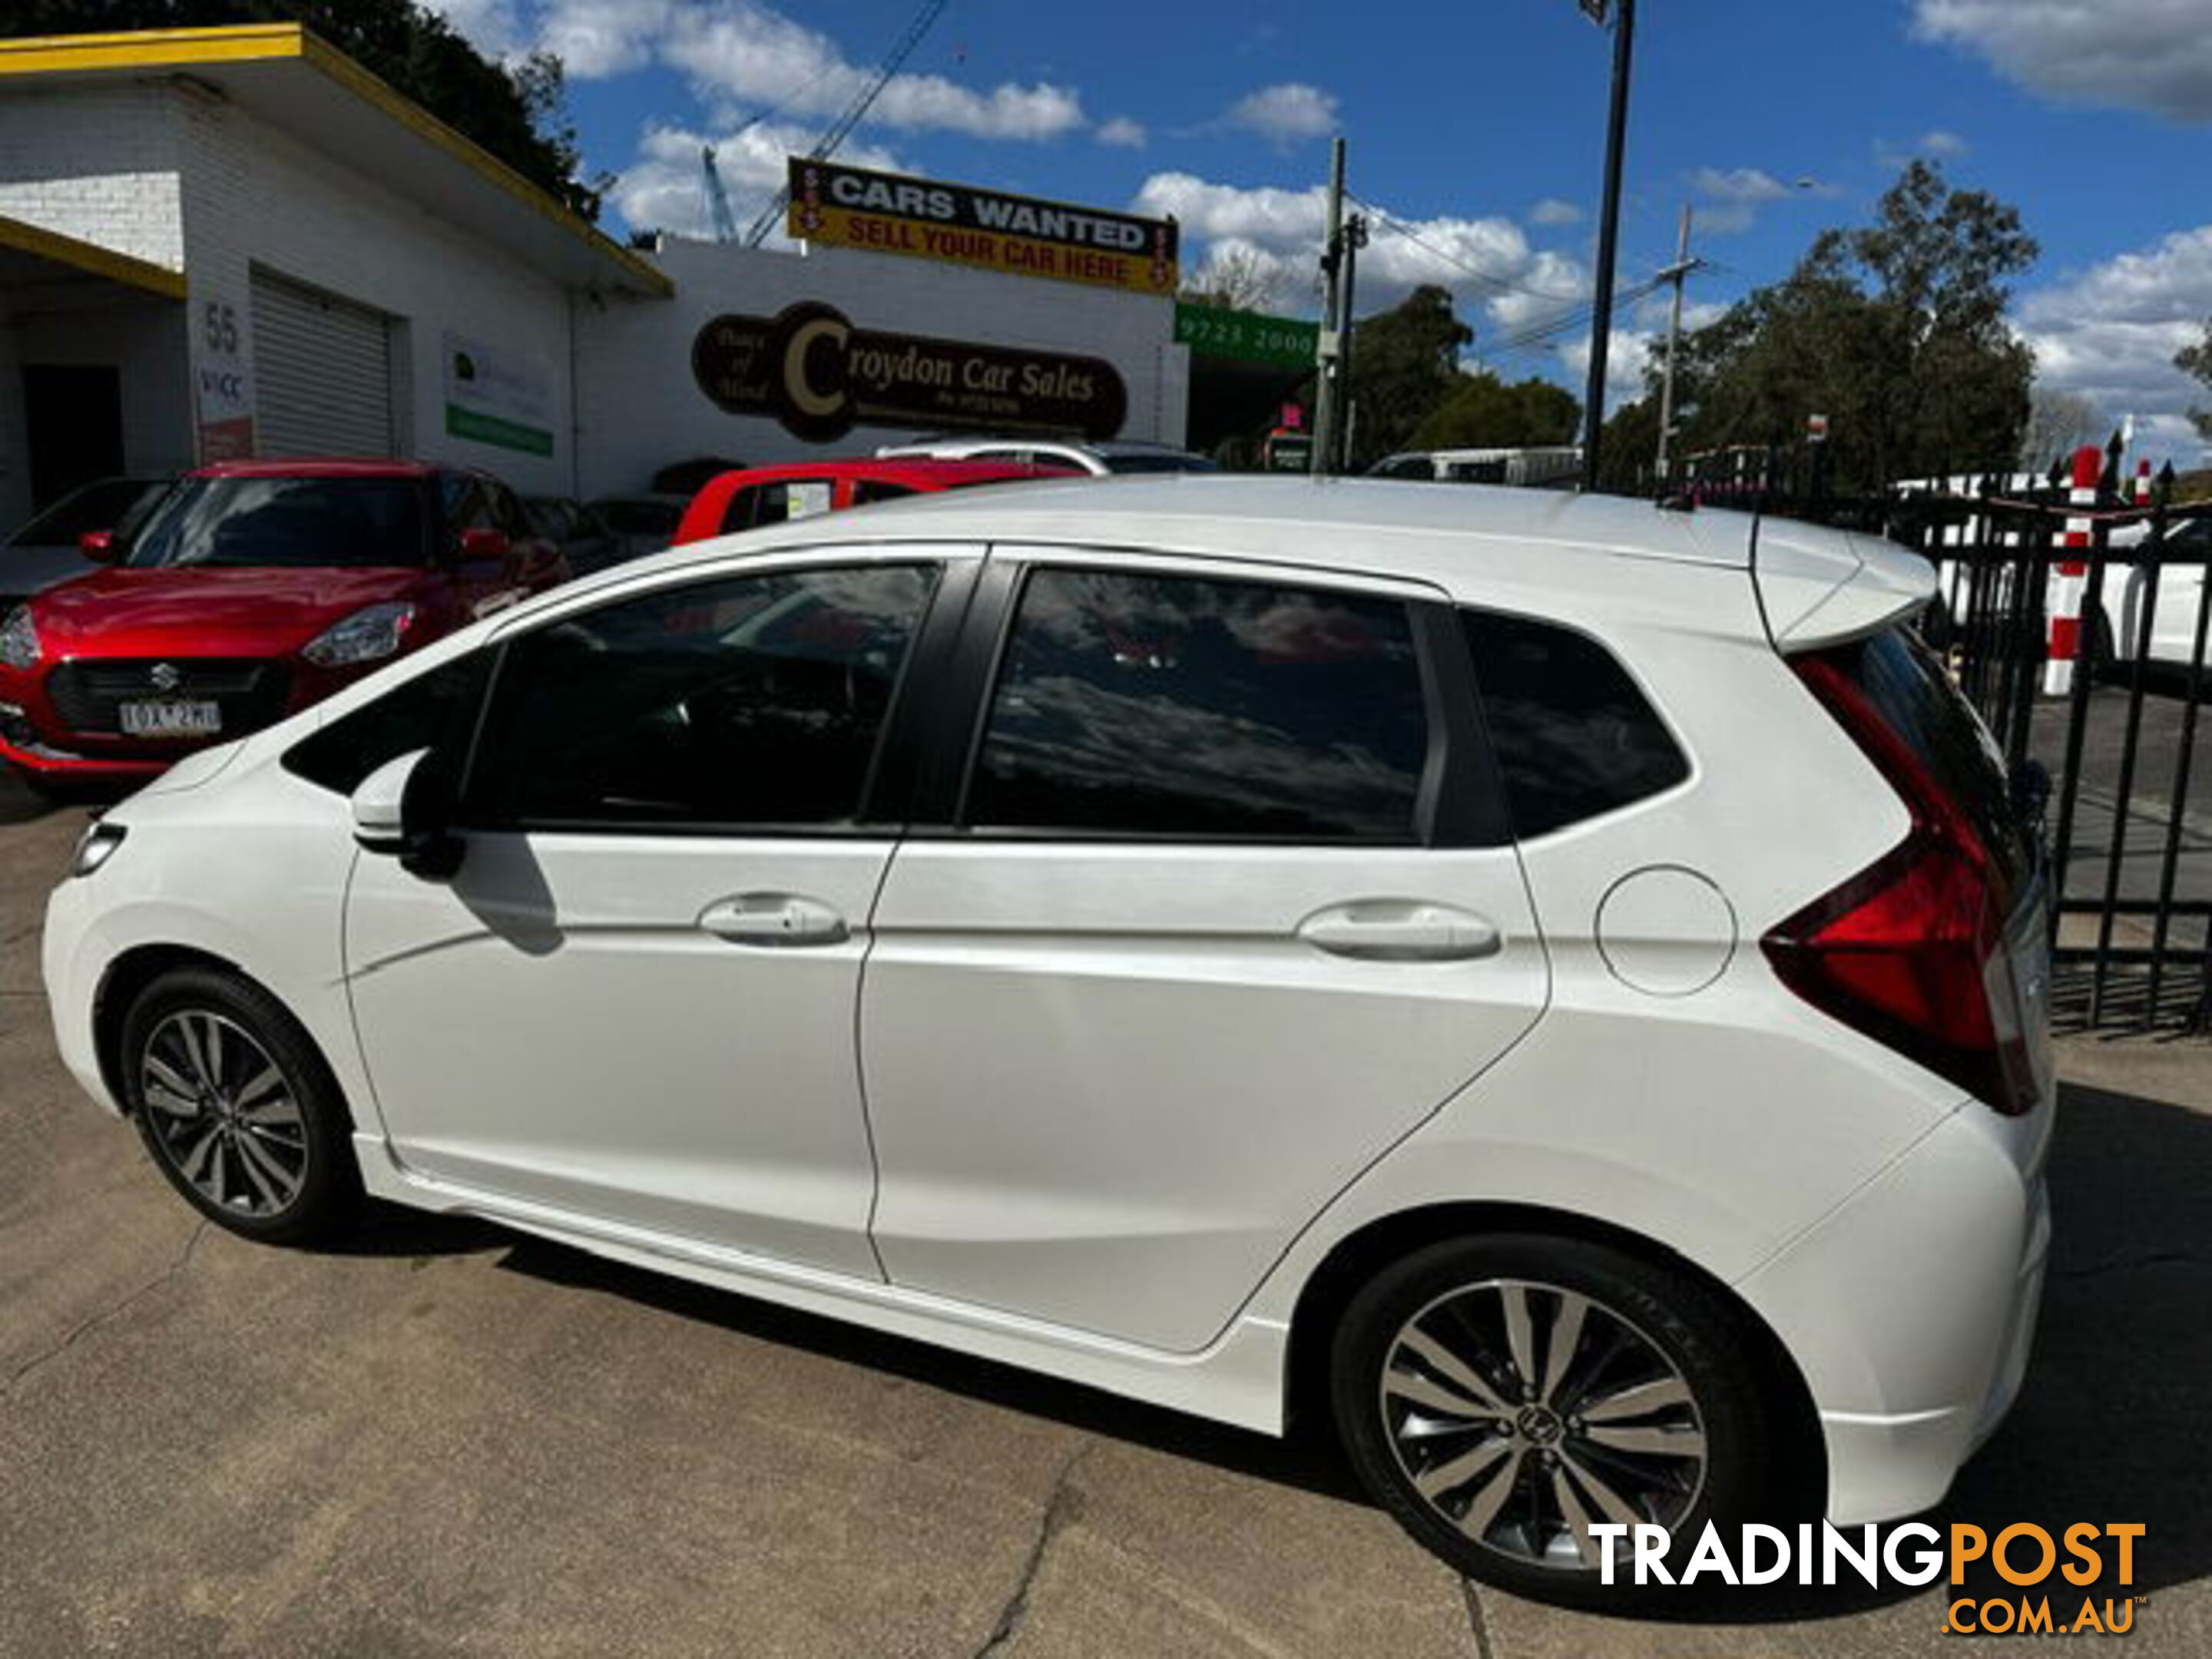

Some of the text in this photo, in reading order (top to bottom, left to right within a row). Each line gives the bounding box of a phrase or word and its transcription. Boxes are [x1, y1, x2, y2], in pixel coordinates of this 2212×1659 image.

[832, 175, 955, 220] CARS
[972, 197, 1144, 250] WANTED
[848, 215, 917, 252] SELL
[925, 225, 995, 262] YOUR
[1003, 239, 1056, 273] CAR
[1065, 250, 1131, 283] HERE
[207, 303, 237, 354] 55
[784, 317, 952, 416] Croydon
[962, 357, 1013, 392] Car
[1020, 363, 1094, 402] Sales
